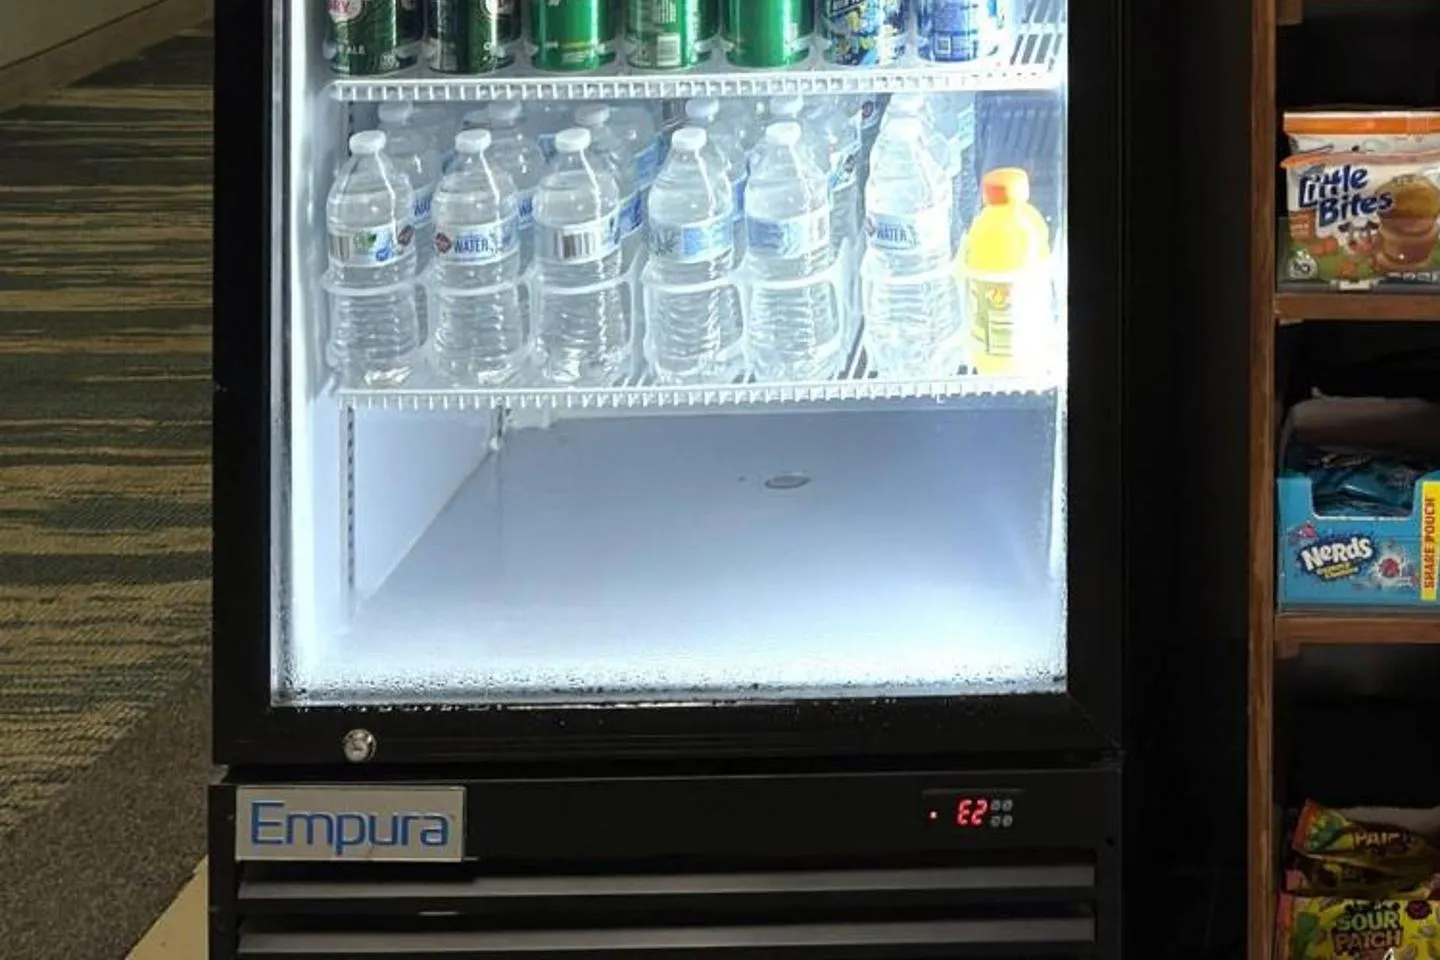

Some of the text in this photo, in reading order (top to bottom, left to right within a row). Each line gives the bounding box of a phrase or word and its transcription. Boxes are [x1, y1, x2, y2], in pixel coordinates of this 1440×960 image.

[1299, 164, 1369, 209] Little
[1319, 191, 1394, 228] Bites
[1424, 547, 1436, 589] SHARE
[250, 801, 450, 856] Empura
[1335, 930, 1403, 949] PATCH
[1336, 911, 1400, 931] SOUR
